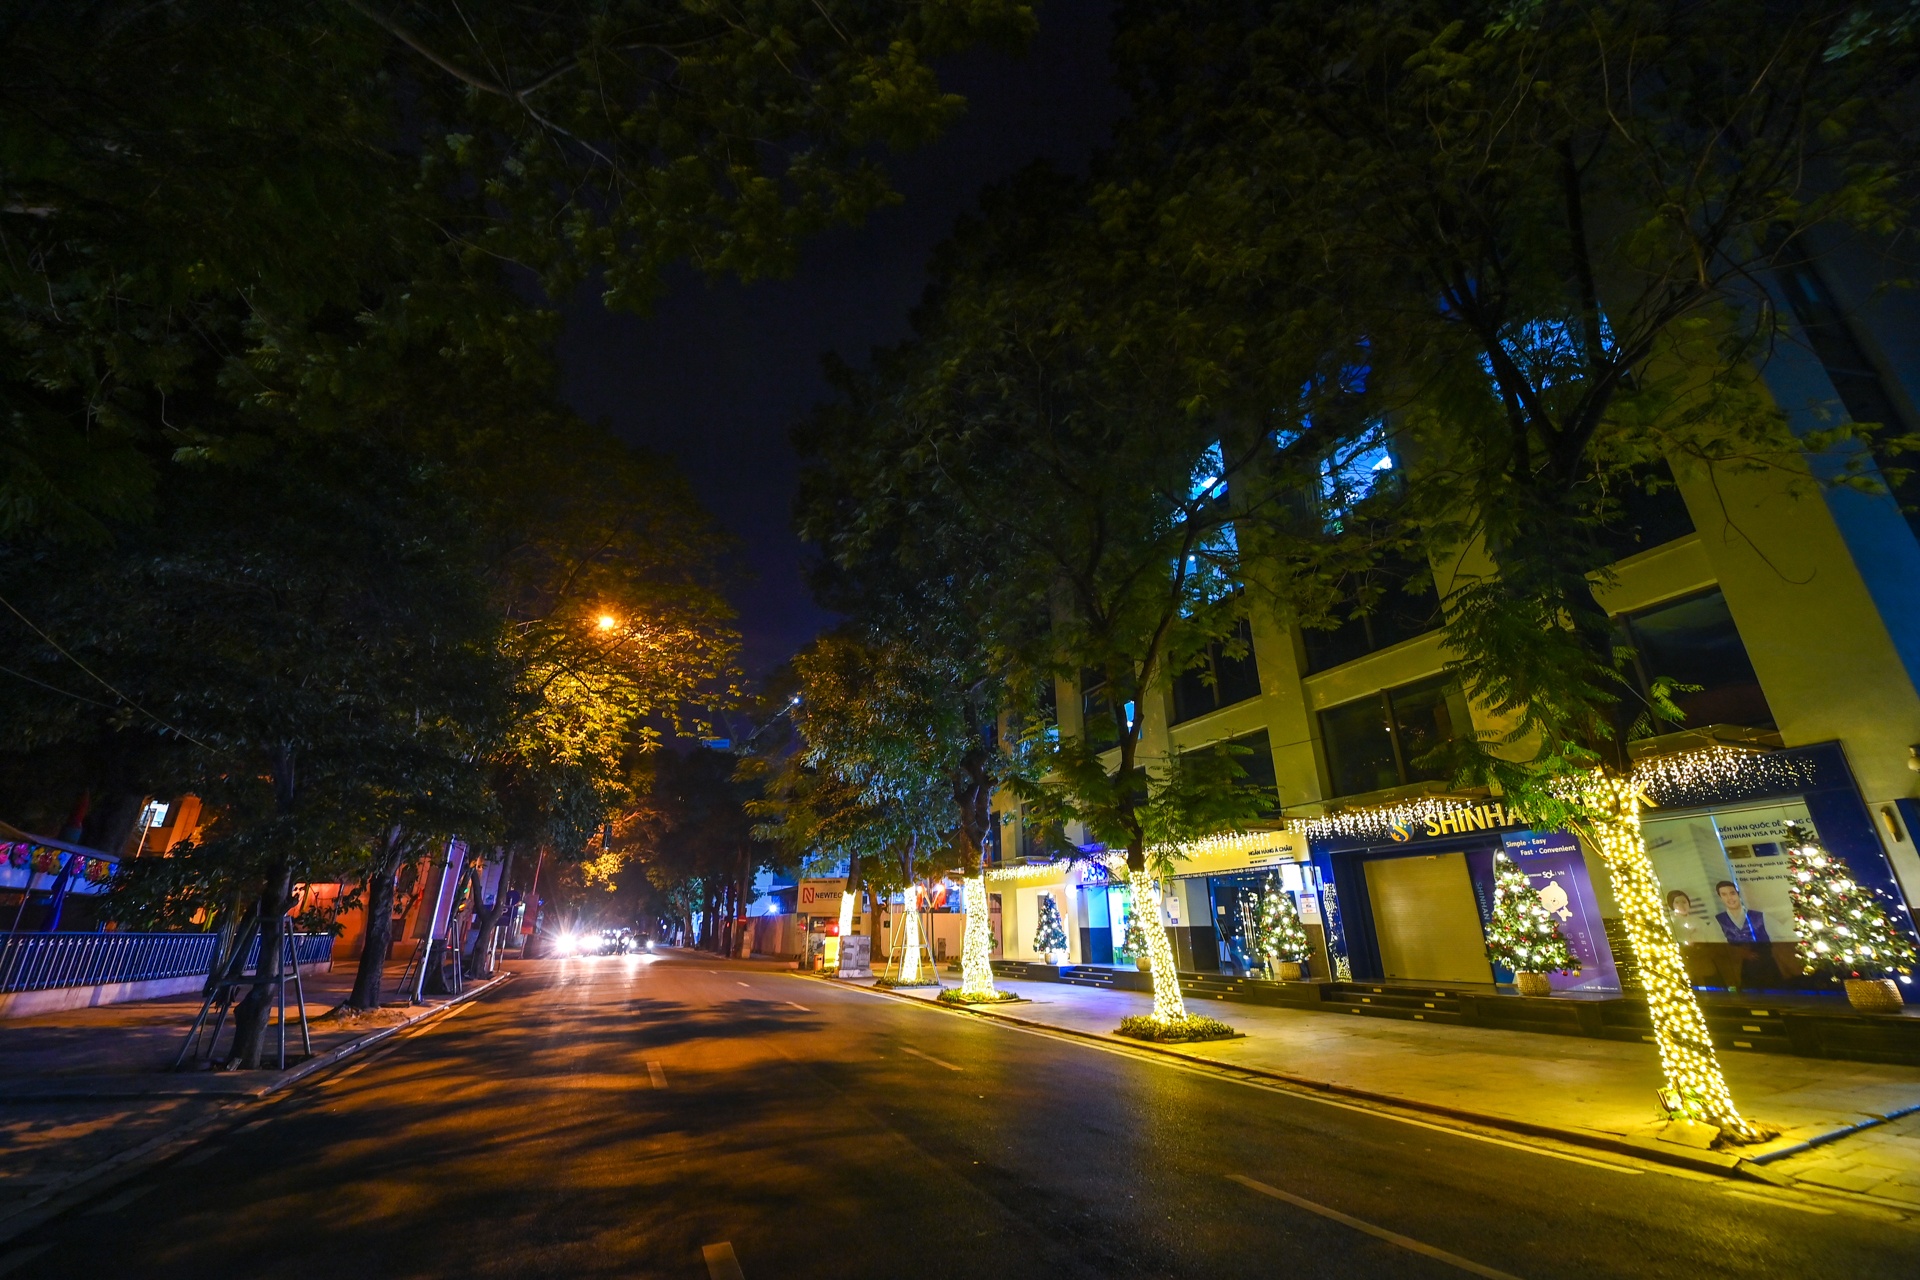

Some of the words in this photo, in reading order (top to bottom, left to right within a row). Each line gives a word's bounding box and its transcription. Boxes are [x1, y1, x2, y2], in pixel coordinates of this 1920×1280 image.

[1424, 800, 1549, 837] SHINHA
[1733, 823, 1748, 832] HÀN
[1749, 820, 1770, 831] QUỐC
[1720, 832, 1751, 840] SHINHAN
[1505, 839, 1527, 848] Simple
[1531, 838, 1547, 846] Easy
[1538, 845, 1577, 854] Convenient
[802, 887, 815, 904] N
[815, 891, 843, 899] NEWTEC
[1476, 881, 1491, 920] SHINHAN
